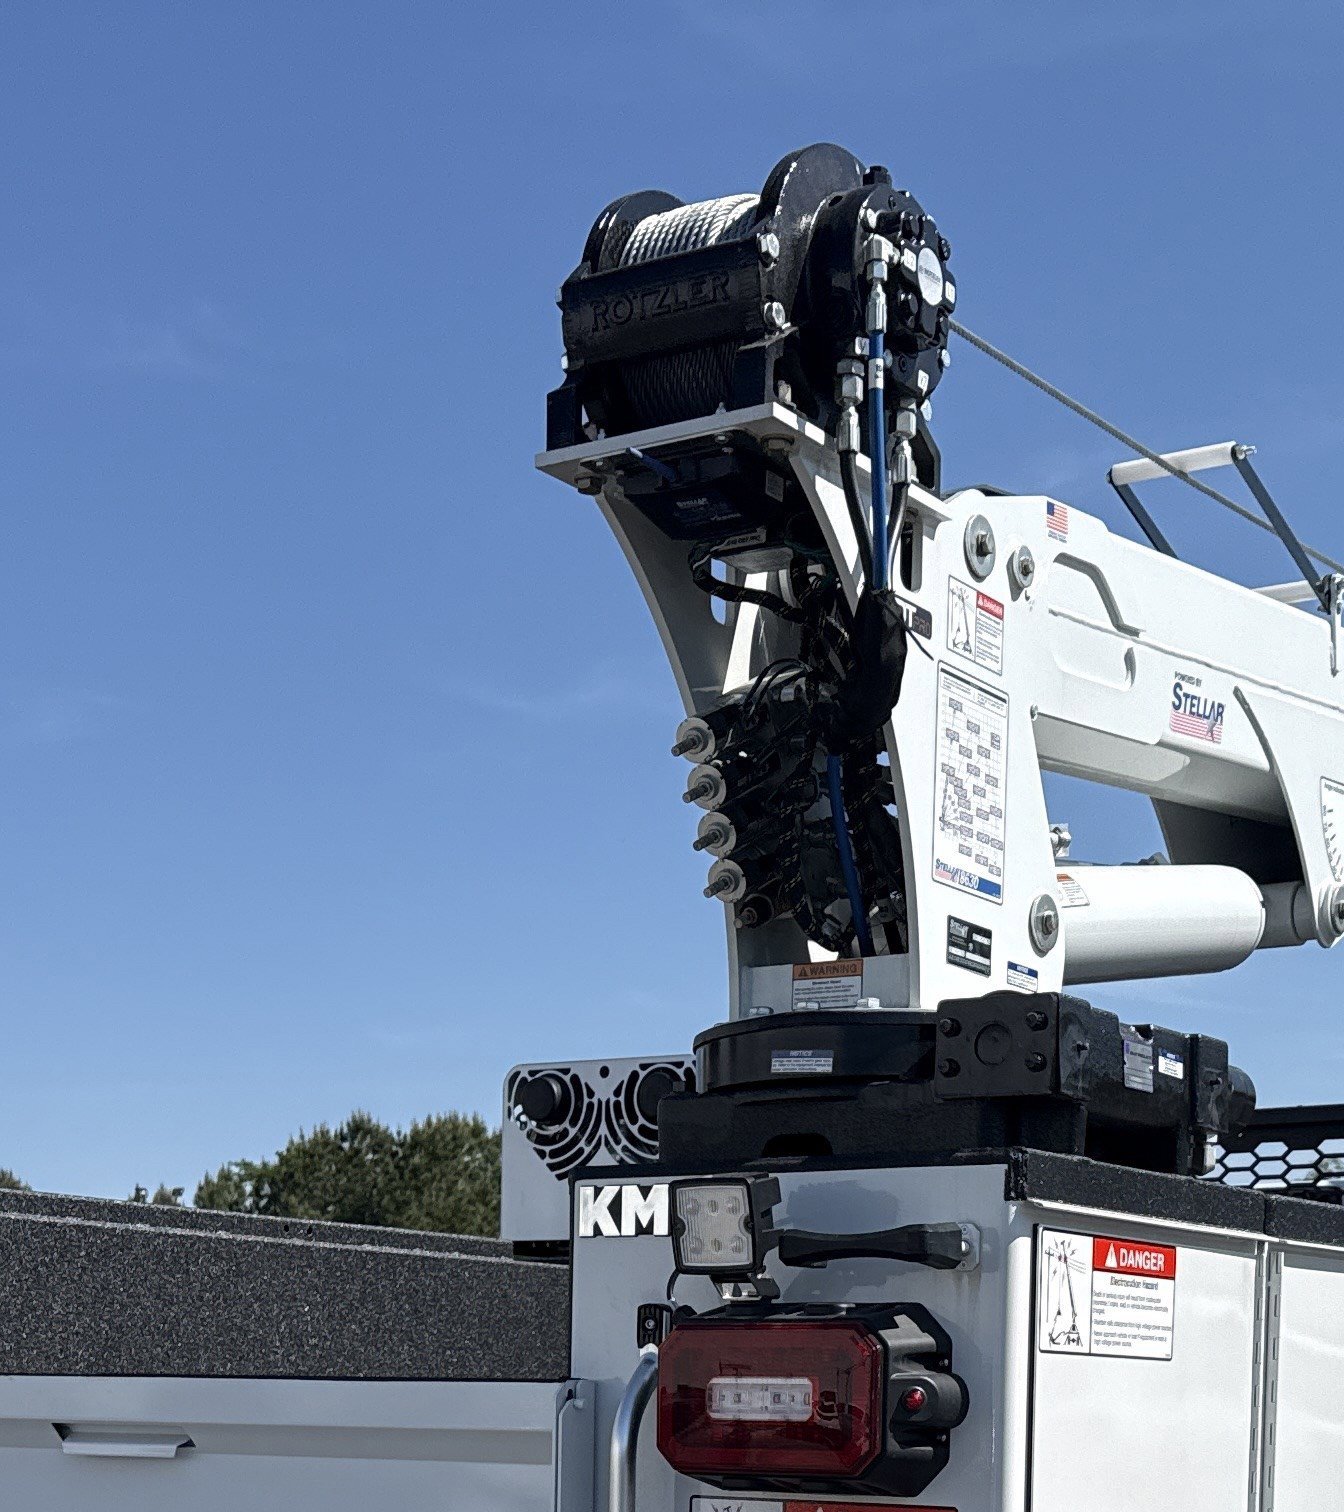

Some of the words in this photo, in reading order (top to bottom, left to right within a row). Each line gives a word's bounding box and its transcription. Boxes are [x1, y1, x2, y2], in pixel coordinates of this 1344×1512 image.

[591, 271, 731, 333] ROTZLER
[1172, 682, 1225, 725] STELLAR
[809, 963, 858, 976] WARNING
[579, 1184, 669, 1236] KM
[1119, 1247, 1165, 1272] DANGER
